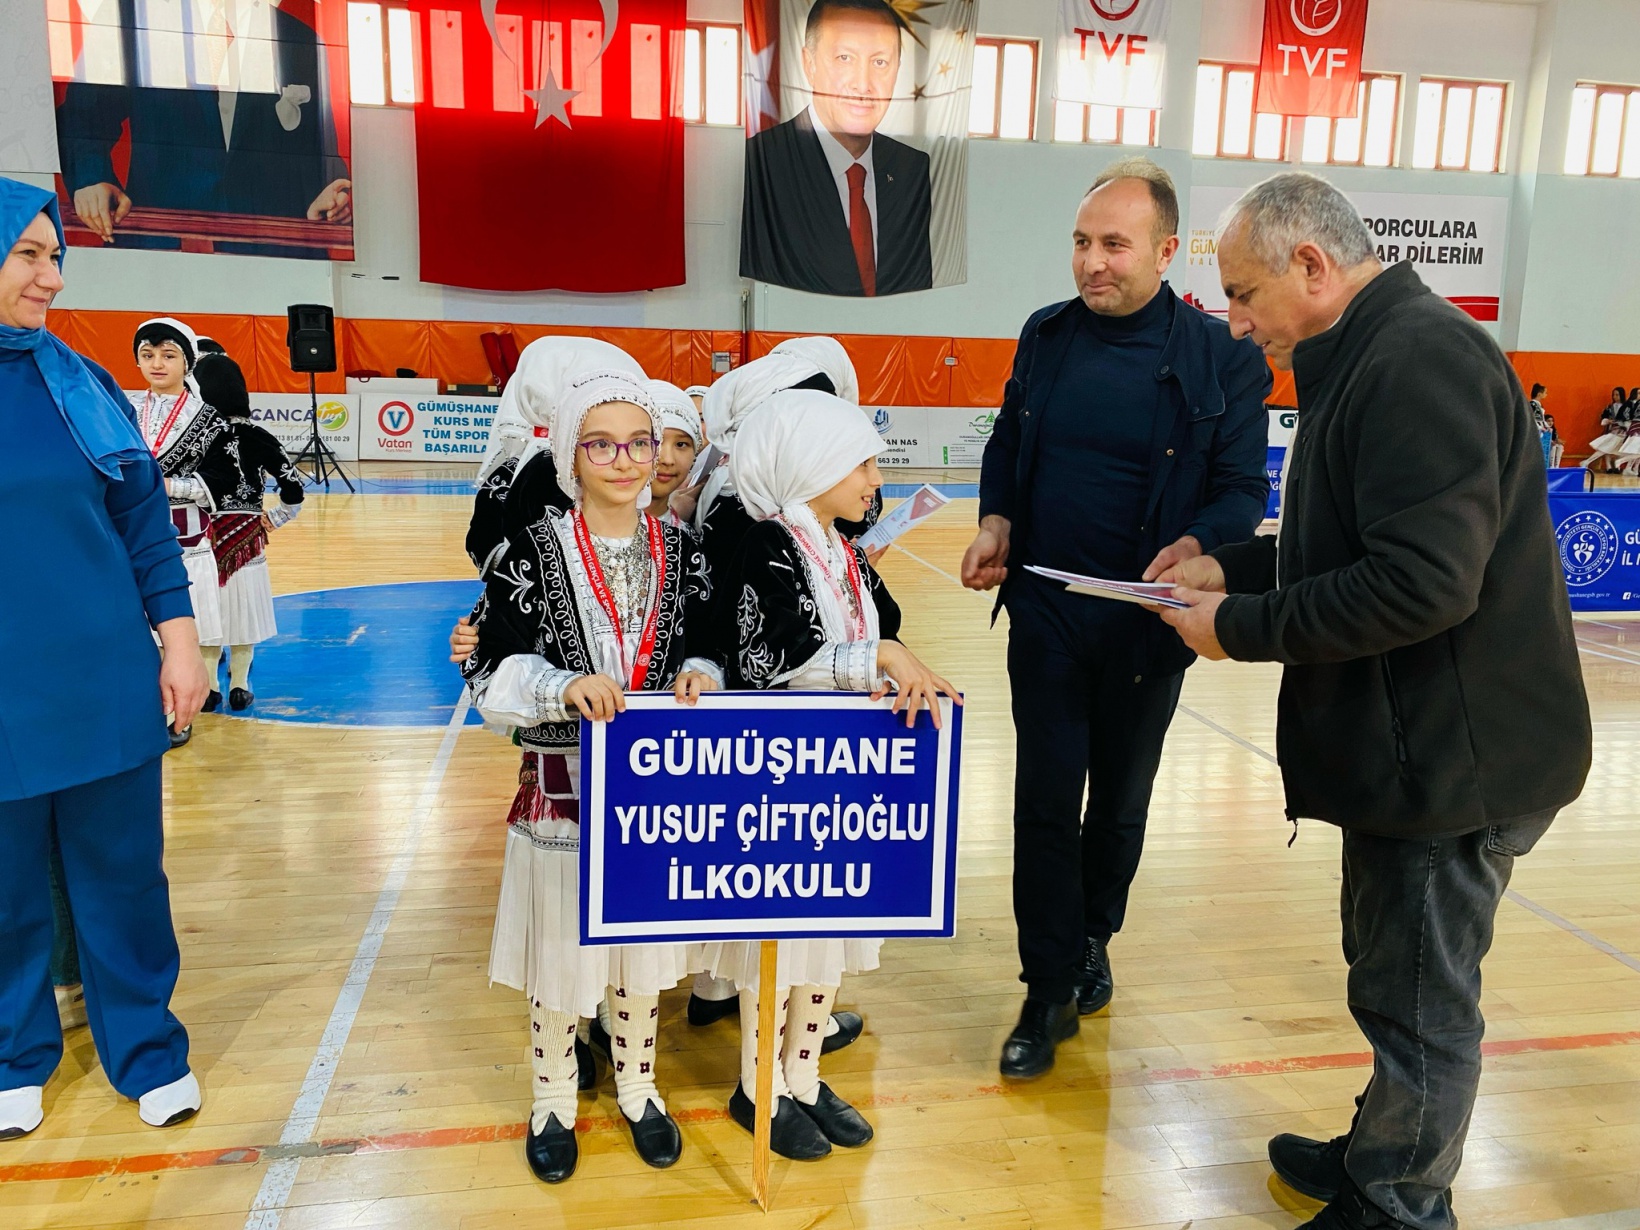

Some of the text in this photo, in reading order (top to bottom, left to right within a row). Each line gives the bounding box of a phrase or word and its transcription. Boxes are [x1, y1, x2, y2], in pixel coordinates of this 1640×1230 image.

[1073, 27, 1148, 66] TVF
[1277, 43, 1348, 79] TVF
[1406, 241, 1484, 265] DİLERİM
[417, 400, 499, 415] GÜMÜŞHANE
[434, 416, 470, 427] KURS
[377, 437, 413, 448] Vatan
[423, 427, 490, 441] TÜM SPOR
[1621, 550, 1633, 566] İL
[588, 560, 604, 590] GENÇLİK
[598, 588, 607, 600] VE
[629, 730, 917, 785] GÜMÜŞHANE
[615, 793, 929, 853] YUSUF ÇİFTÇİOĞLU
[668, 857, 871, 900] İLKOKULU
